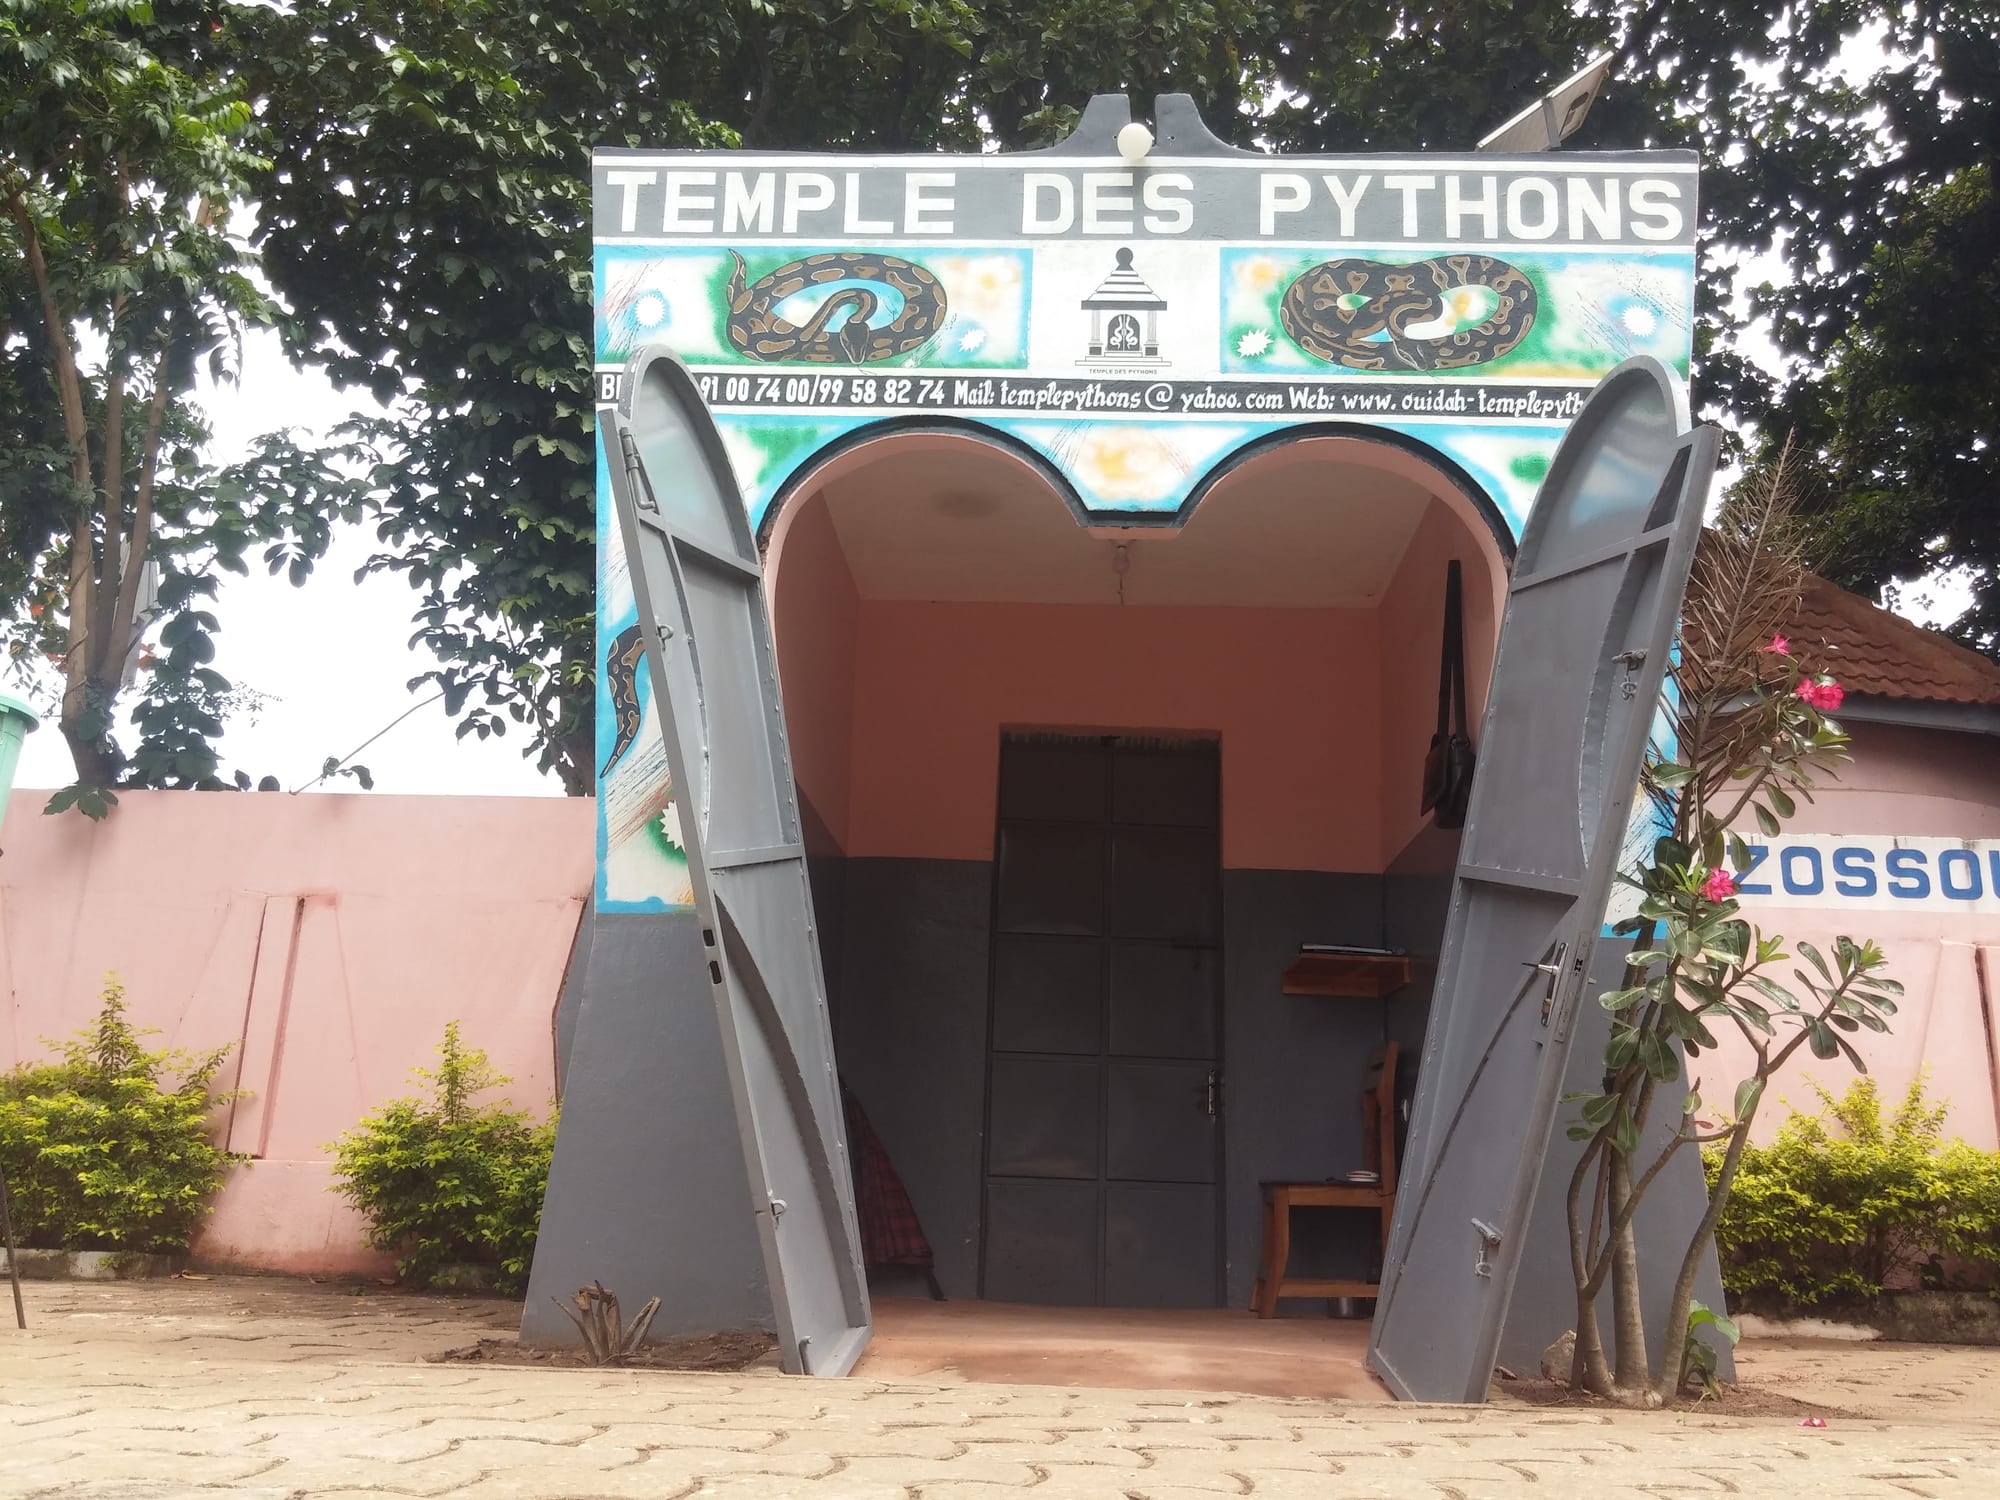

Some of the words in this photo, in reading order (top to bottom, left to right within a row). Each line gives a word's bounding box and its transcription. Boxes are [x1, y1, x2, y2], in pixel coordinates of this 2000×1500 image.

[606, 170, 956, 235] TEMPLE
[1020, 171, 1195, 236] DES
[1257, 173, 1684, 242] PYTHONS
[725, 377, 750, 402] 00
[754, 377, 781, 403] 74
[850, 379, 877, 404] 58
[883, 379, 912, 404] 82
[916, 380, 945, 405] 74
[953, 380, 995, 406] Mail:
[1288, 386, 1336, 411] Web:
